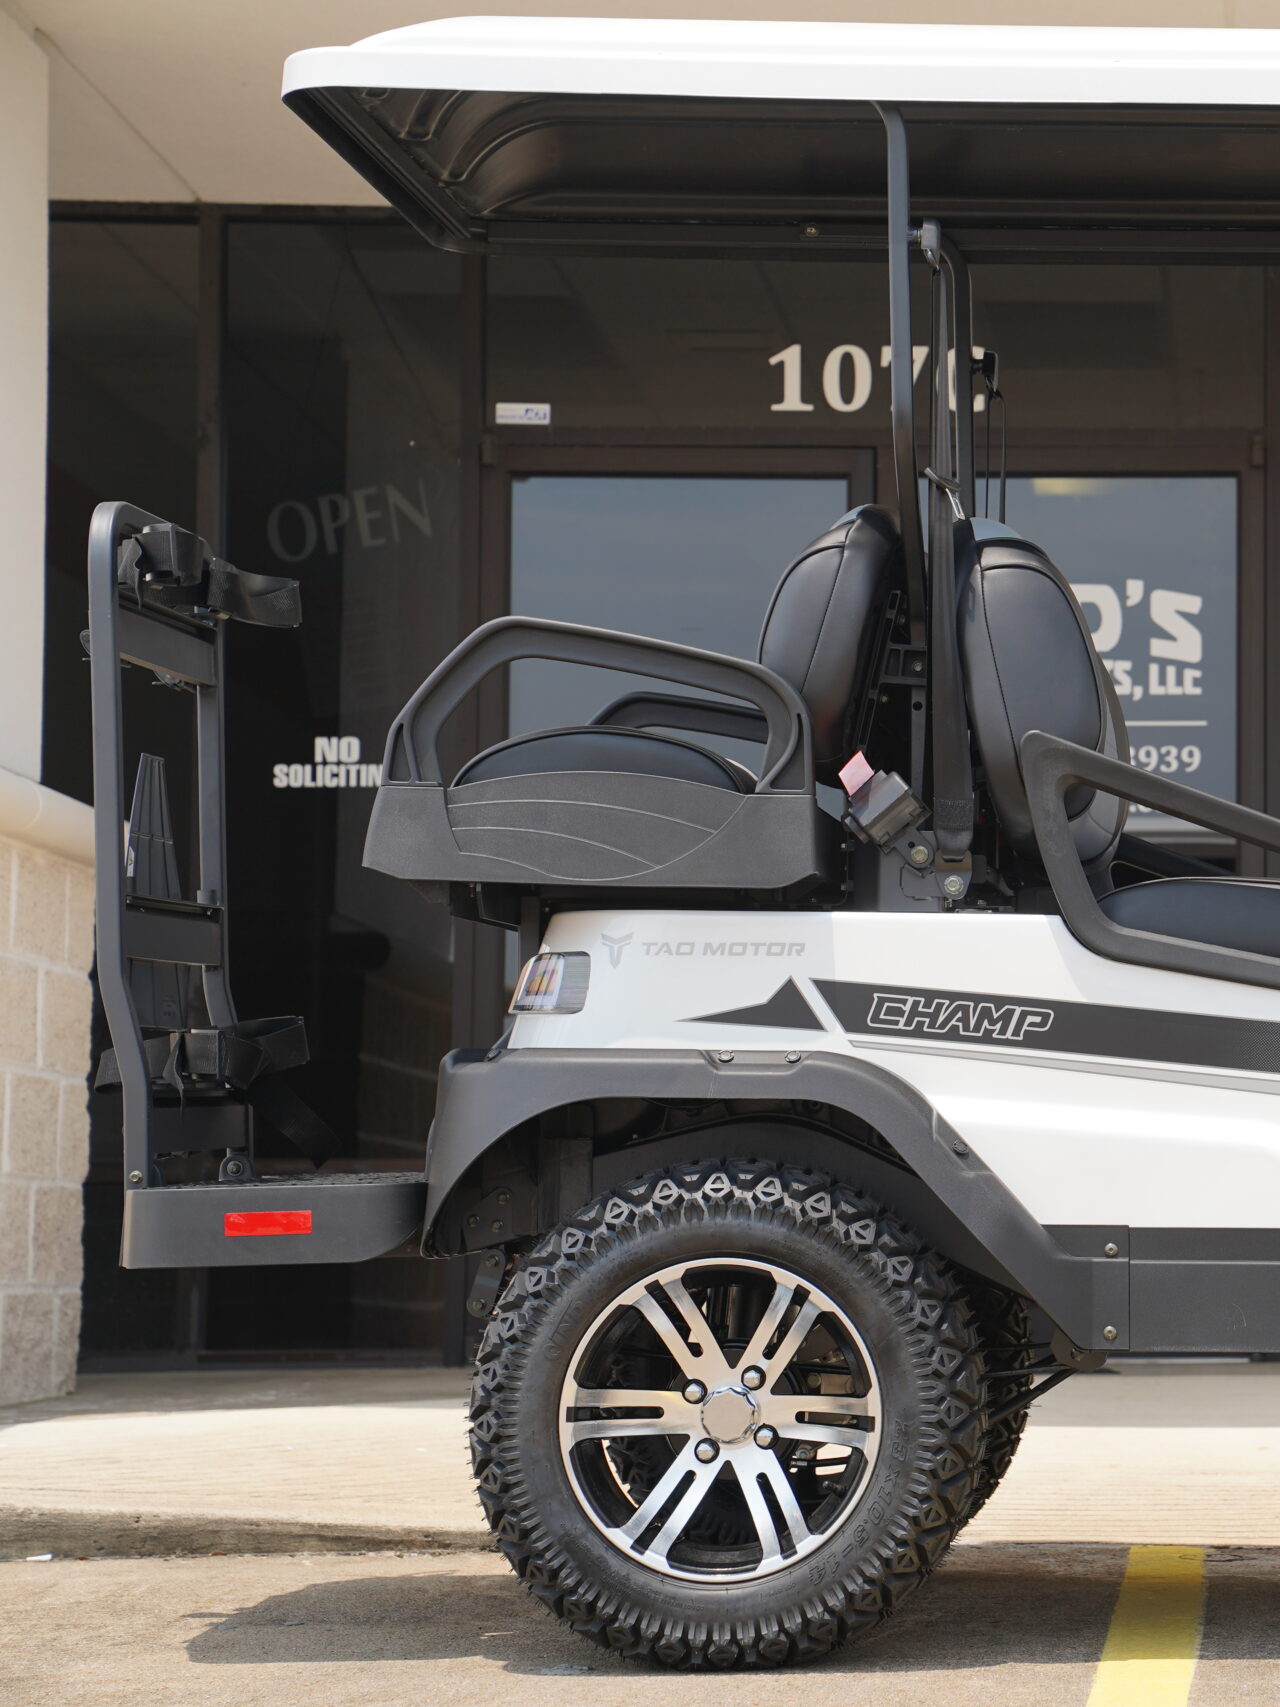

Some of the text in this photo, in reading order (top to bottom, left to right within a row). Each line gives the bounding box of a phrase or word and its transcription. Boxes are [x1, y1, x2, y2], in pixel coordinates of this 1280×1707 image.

[266, 478, 433, 563] OPEN
[1148, 663, 1203, 695] LLC
[313, 735, 361, 763] NO
[641, 942, 806, 957] TAO MOTOR
[867, 993, 1055, 1040] CHAMP
